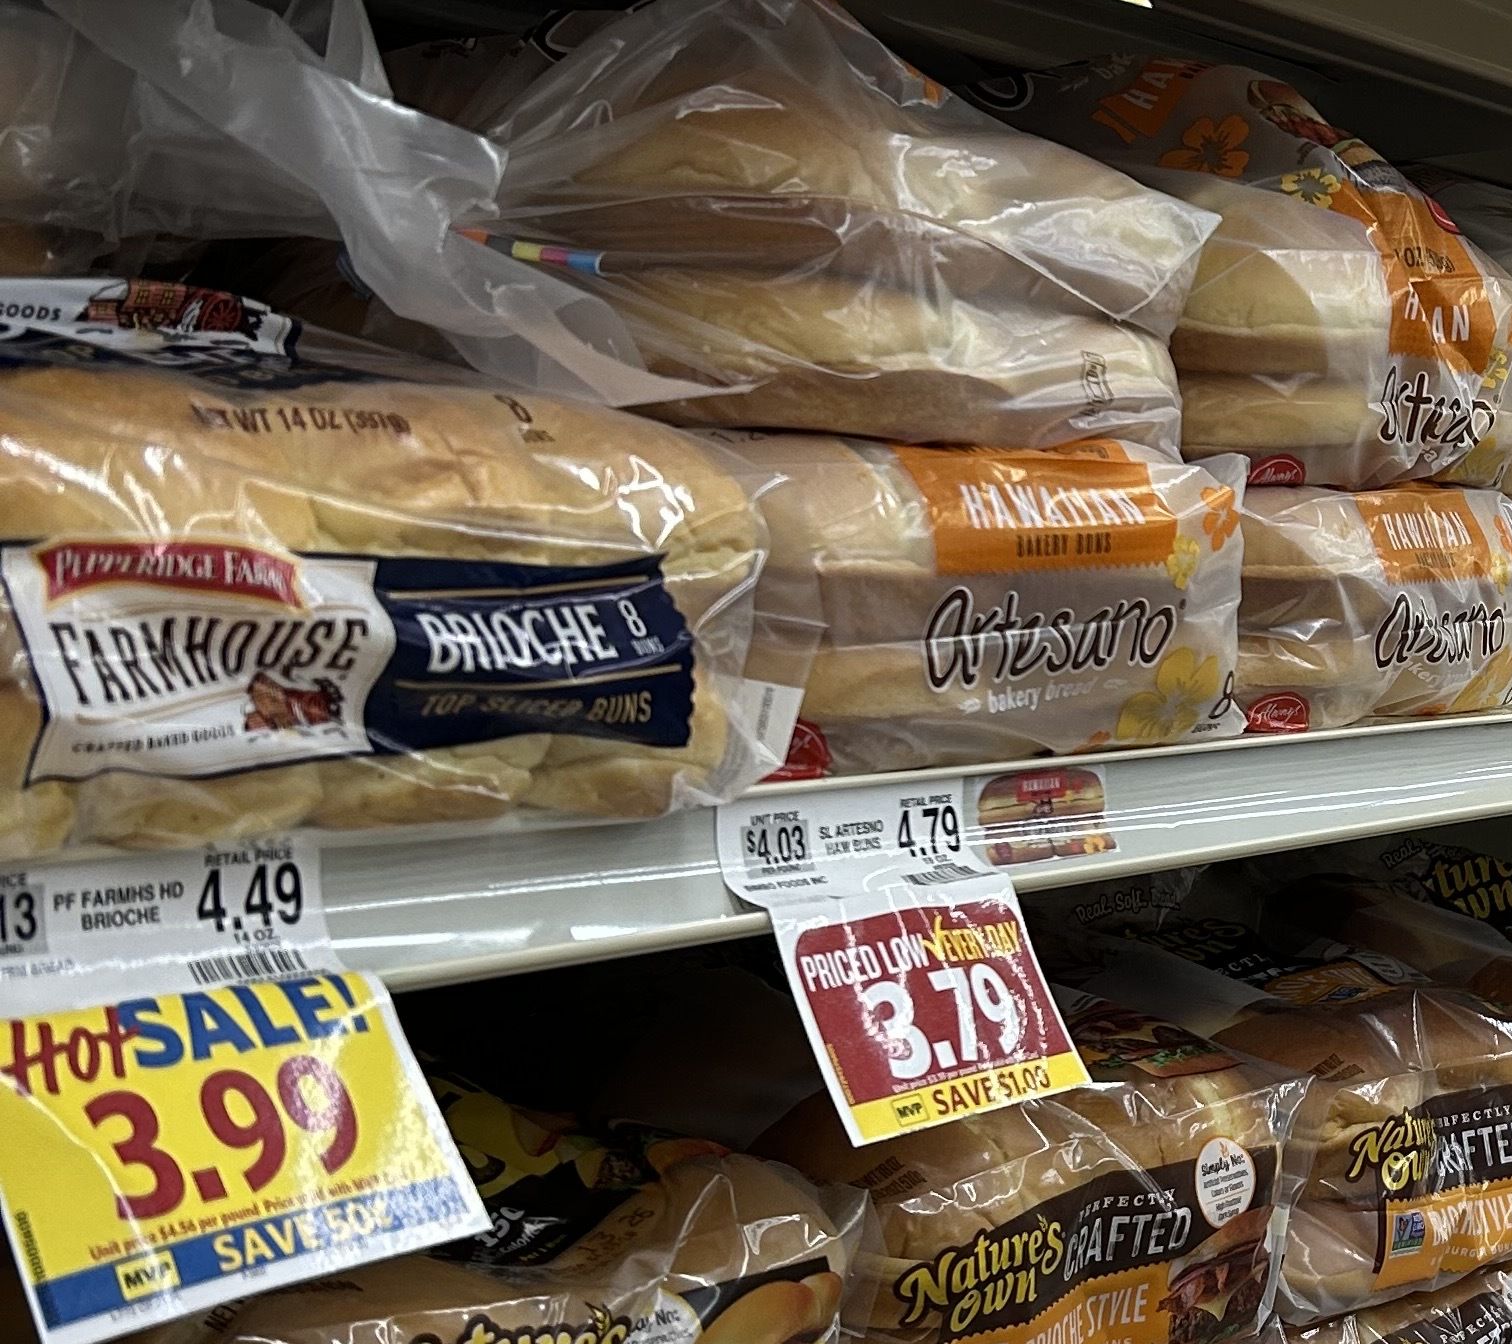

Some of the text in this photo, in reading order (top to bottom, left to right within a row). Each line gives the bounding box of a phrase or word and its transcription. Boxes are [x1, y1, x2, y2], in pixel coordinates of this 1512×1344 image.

[960, 482, 1146, 529] HAWAIIAN
[224, 550, 287, 592] FARM
[1016, 532, 1112, 558] BAKERY BUNS
[50, 615, 369, 705] FARMHOUSE
[416, 600, 647, 673] BRIOCHE 8
[923, 586, 1178, 692] Artesano
[1207, 670, 1235, 719] 8
[746, 824, 806, 864] $4.03
[898, 805, 961, 857] 4.79
[81, 906, 160, 931] BRIOCHE
[196, 862, 303, 933] 4.49
[0, 974, 370, 1096] Hot SALE!
[863, 963, 1022, 1079] 3.79
[896, 1065, 1051, 1118] MVP SAVE $1.00
[84, 1053, 358, 1220] 3.99
[899, 1218, 1065, 1323] Nature's
[1063, 1208, 1192, 1282] CRAFTED
[949, 1270, 1038, 1332] Own
[1087, 1284, 1148, 1335] STYLE
